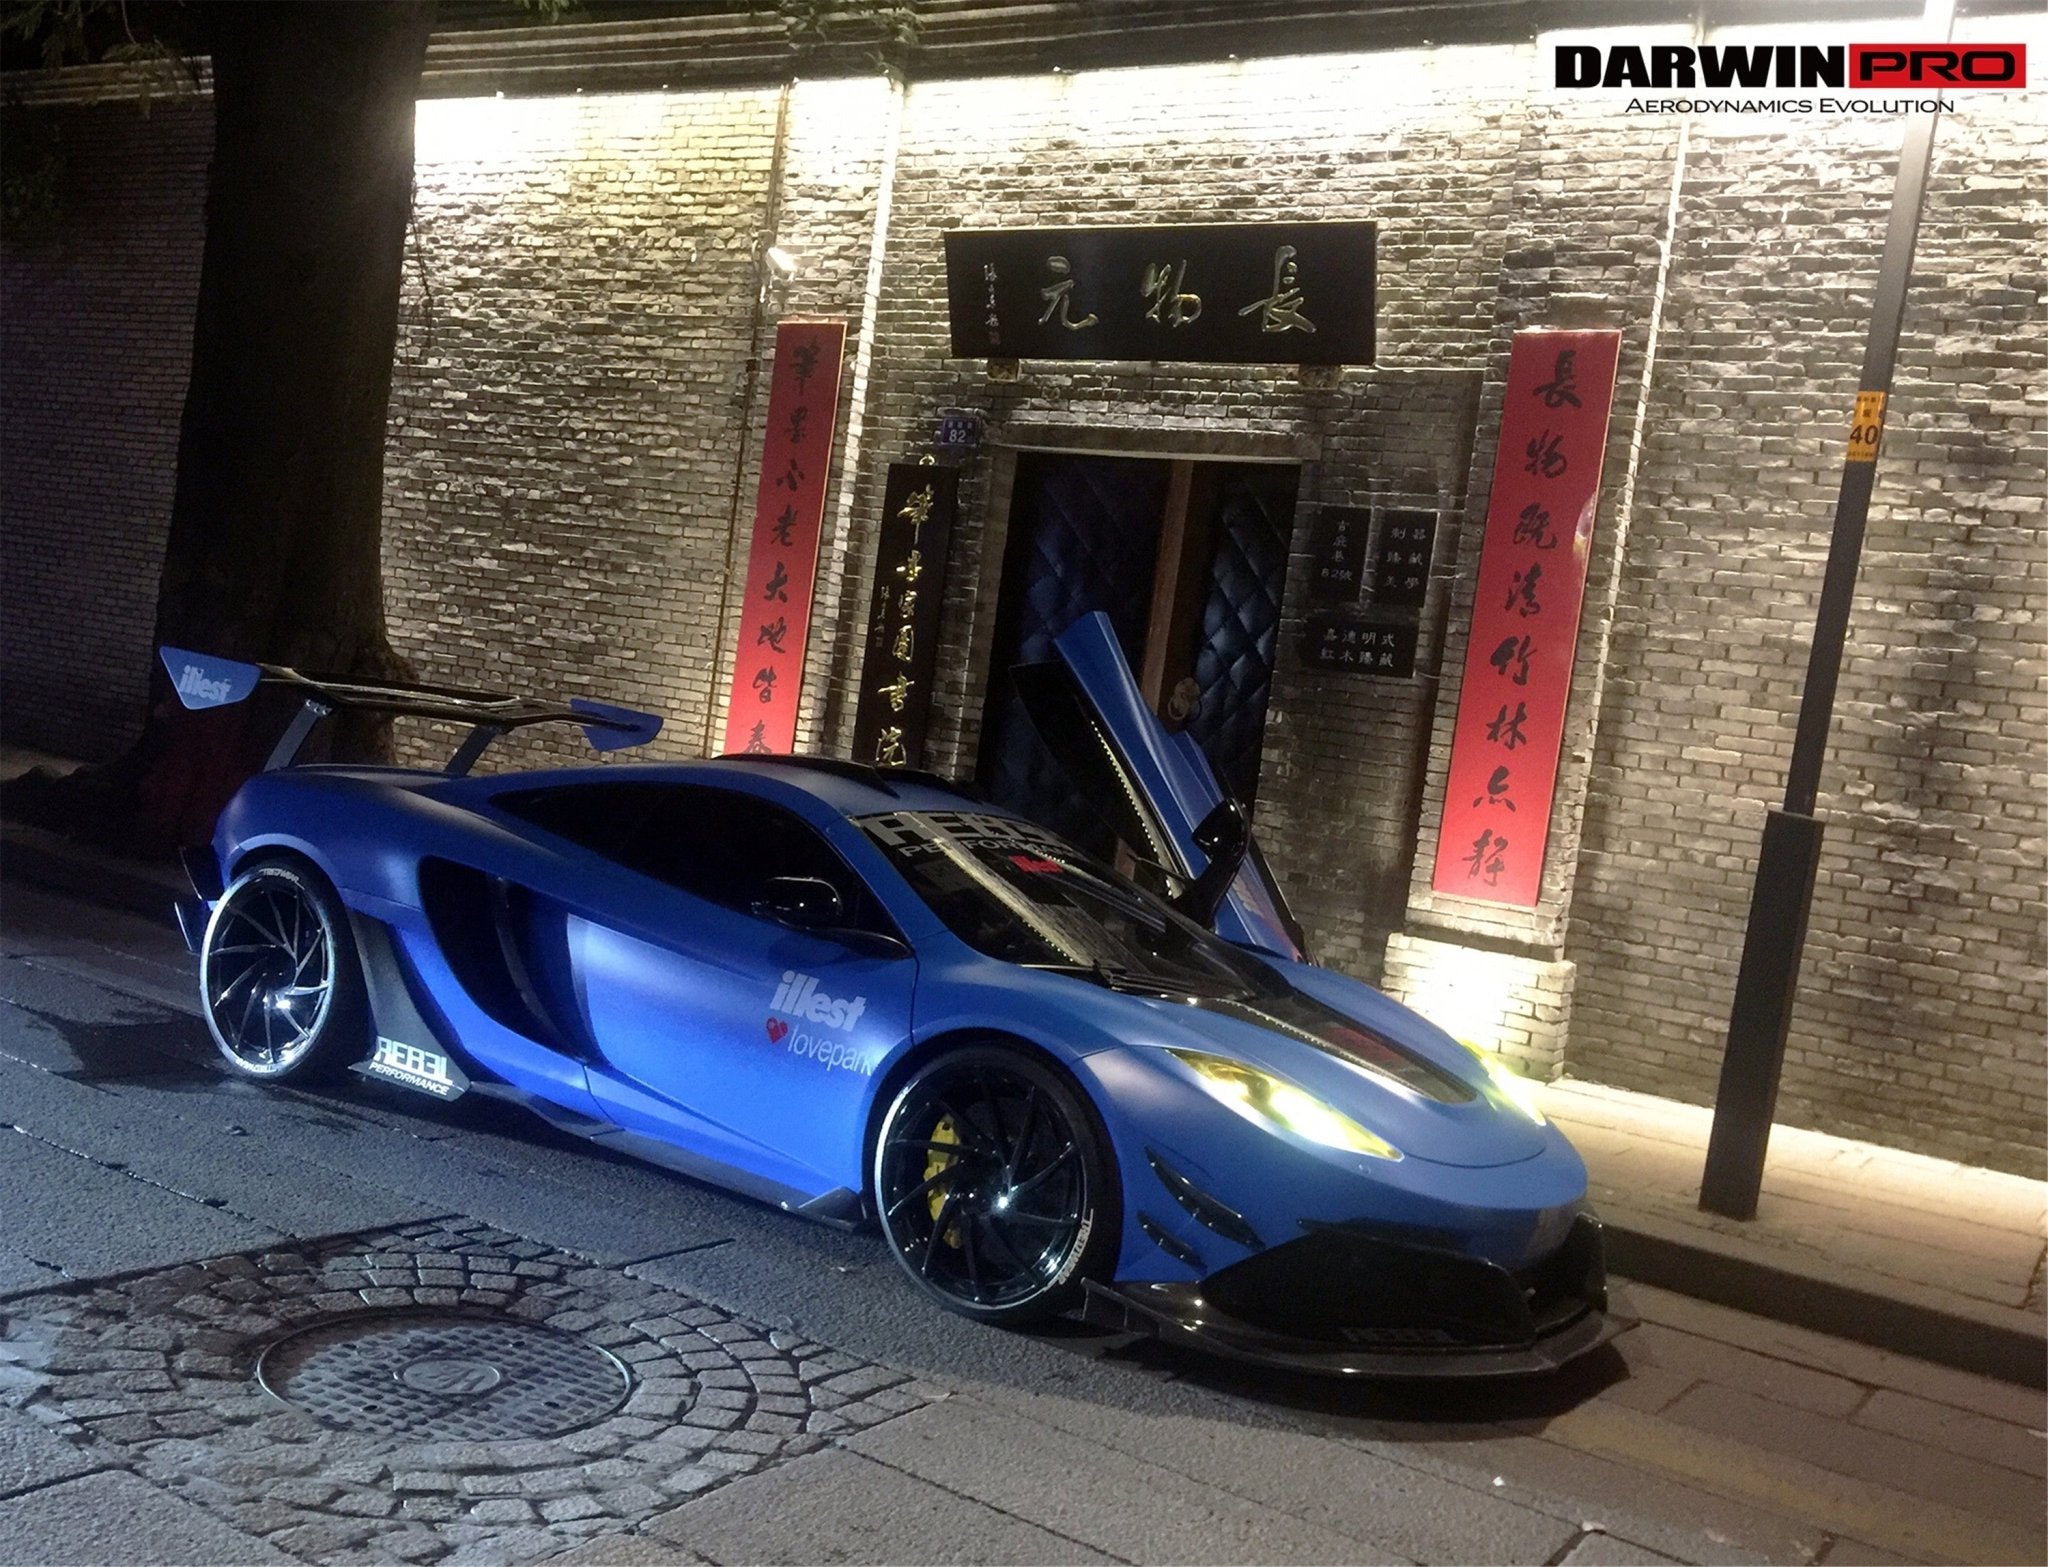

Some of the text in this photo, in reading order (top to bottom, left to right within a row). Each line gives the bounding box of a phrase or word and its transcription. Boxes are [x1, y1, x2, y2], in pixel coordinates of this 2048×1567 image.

[949, 429, 967, 443] 82
[1849, 424, 1878, 445] 40
[179, 665, 232, 704] illest
[769, 970, 867, 1033] illest
[788, 1023, 874, 1077] lovepark
[368, 1061, 450, 1096] PERFORMANCE
